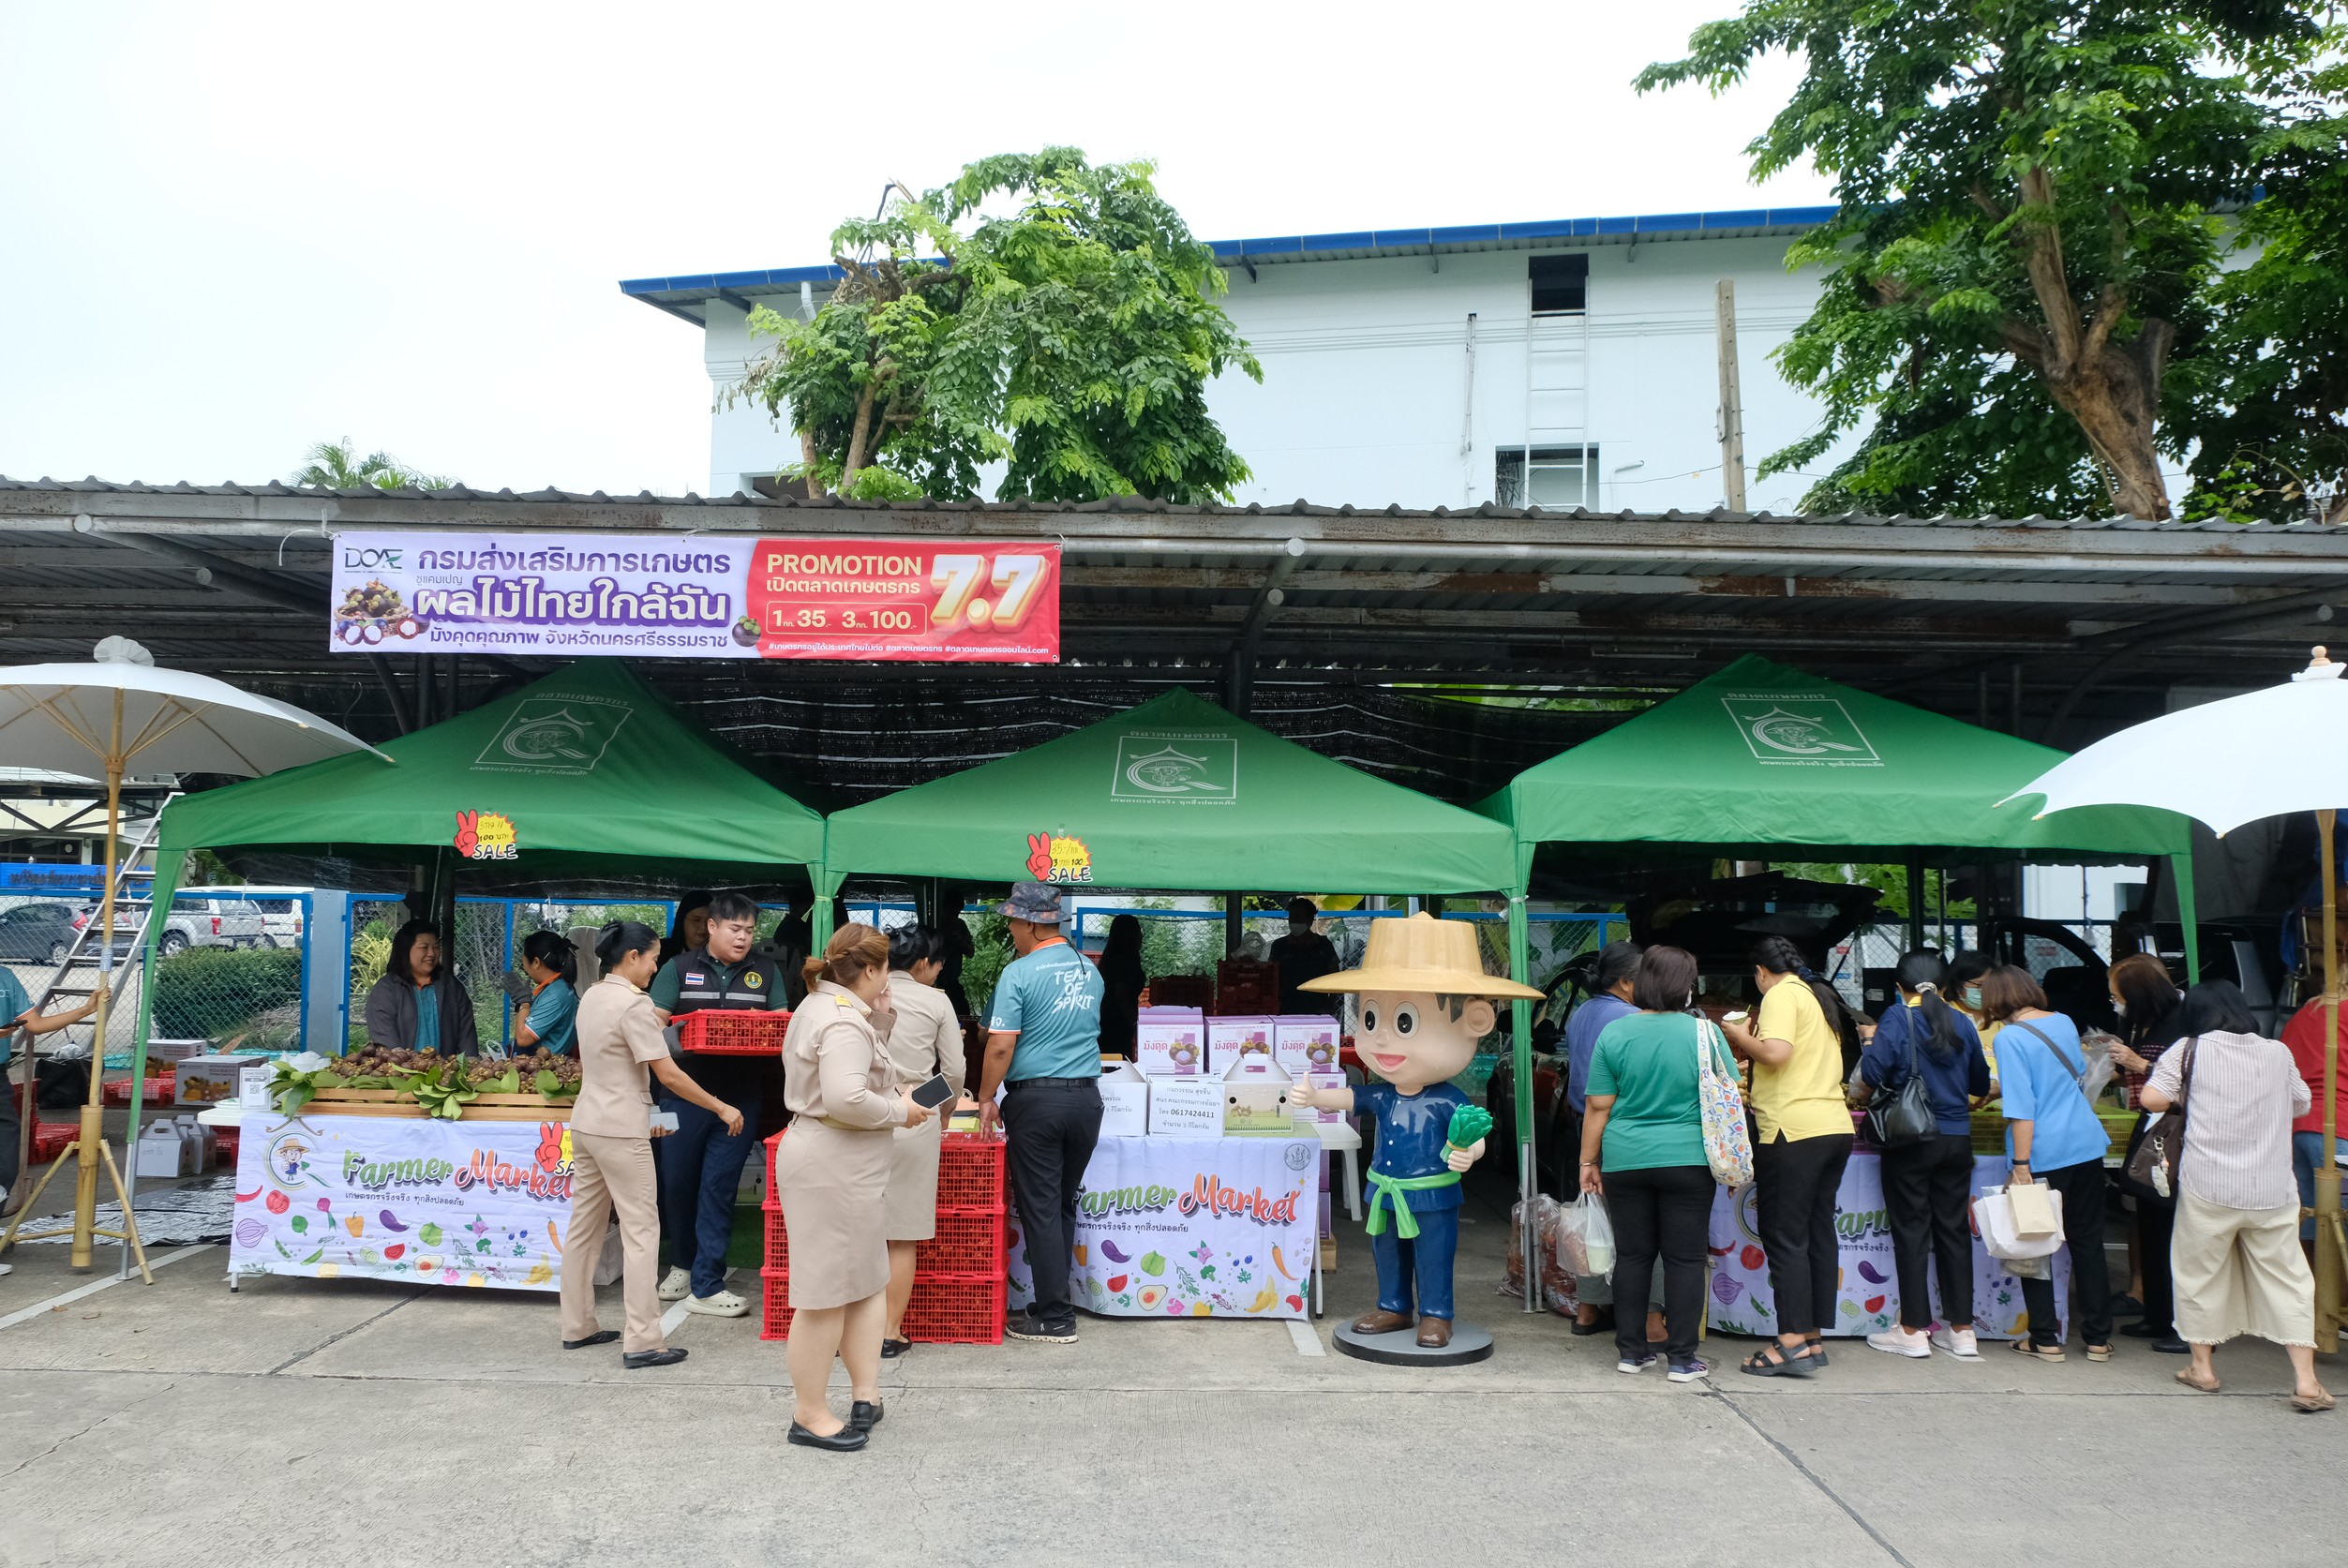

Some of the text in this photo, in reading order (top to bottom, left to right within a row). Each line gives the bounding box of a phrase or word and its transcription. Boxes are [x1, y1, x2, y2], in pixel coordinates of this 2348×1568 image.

[418, 543, 731, 574] กรมส่งเสริมการเกษตร
[767, 554, 922, 575] PROMOTION
[416, 575, 463, 586] ชูแคมเปญ
[766, 576, 921, 594] เปิดตลาดเกษตรกร
[416, 576, 726, 622] ผลไม้ไทยใกล้ฉัน
[931, 554, 1047, 632] 7.7
[429, 626, 728, 648] มังคุดคุณภาพ จังหวัดนครศรีธรรมราช
[473, 844, 518, 859] SALE
[1048, 867, 1093, 883] SALE
[1054, 968, 1092, 985] TEAM
[1065, 981, 1084, 996] OF
[1052, 993, 1095, 1014] SPIRIT
[343, 1149, 455, 1187] Farmer
[555, 1160, 576, 1176] SA
[1075, 1172, 1301, 1222] armer Market
